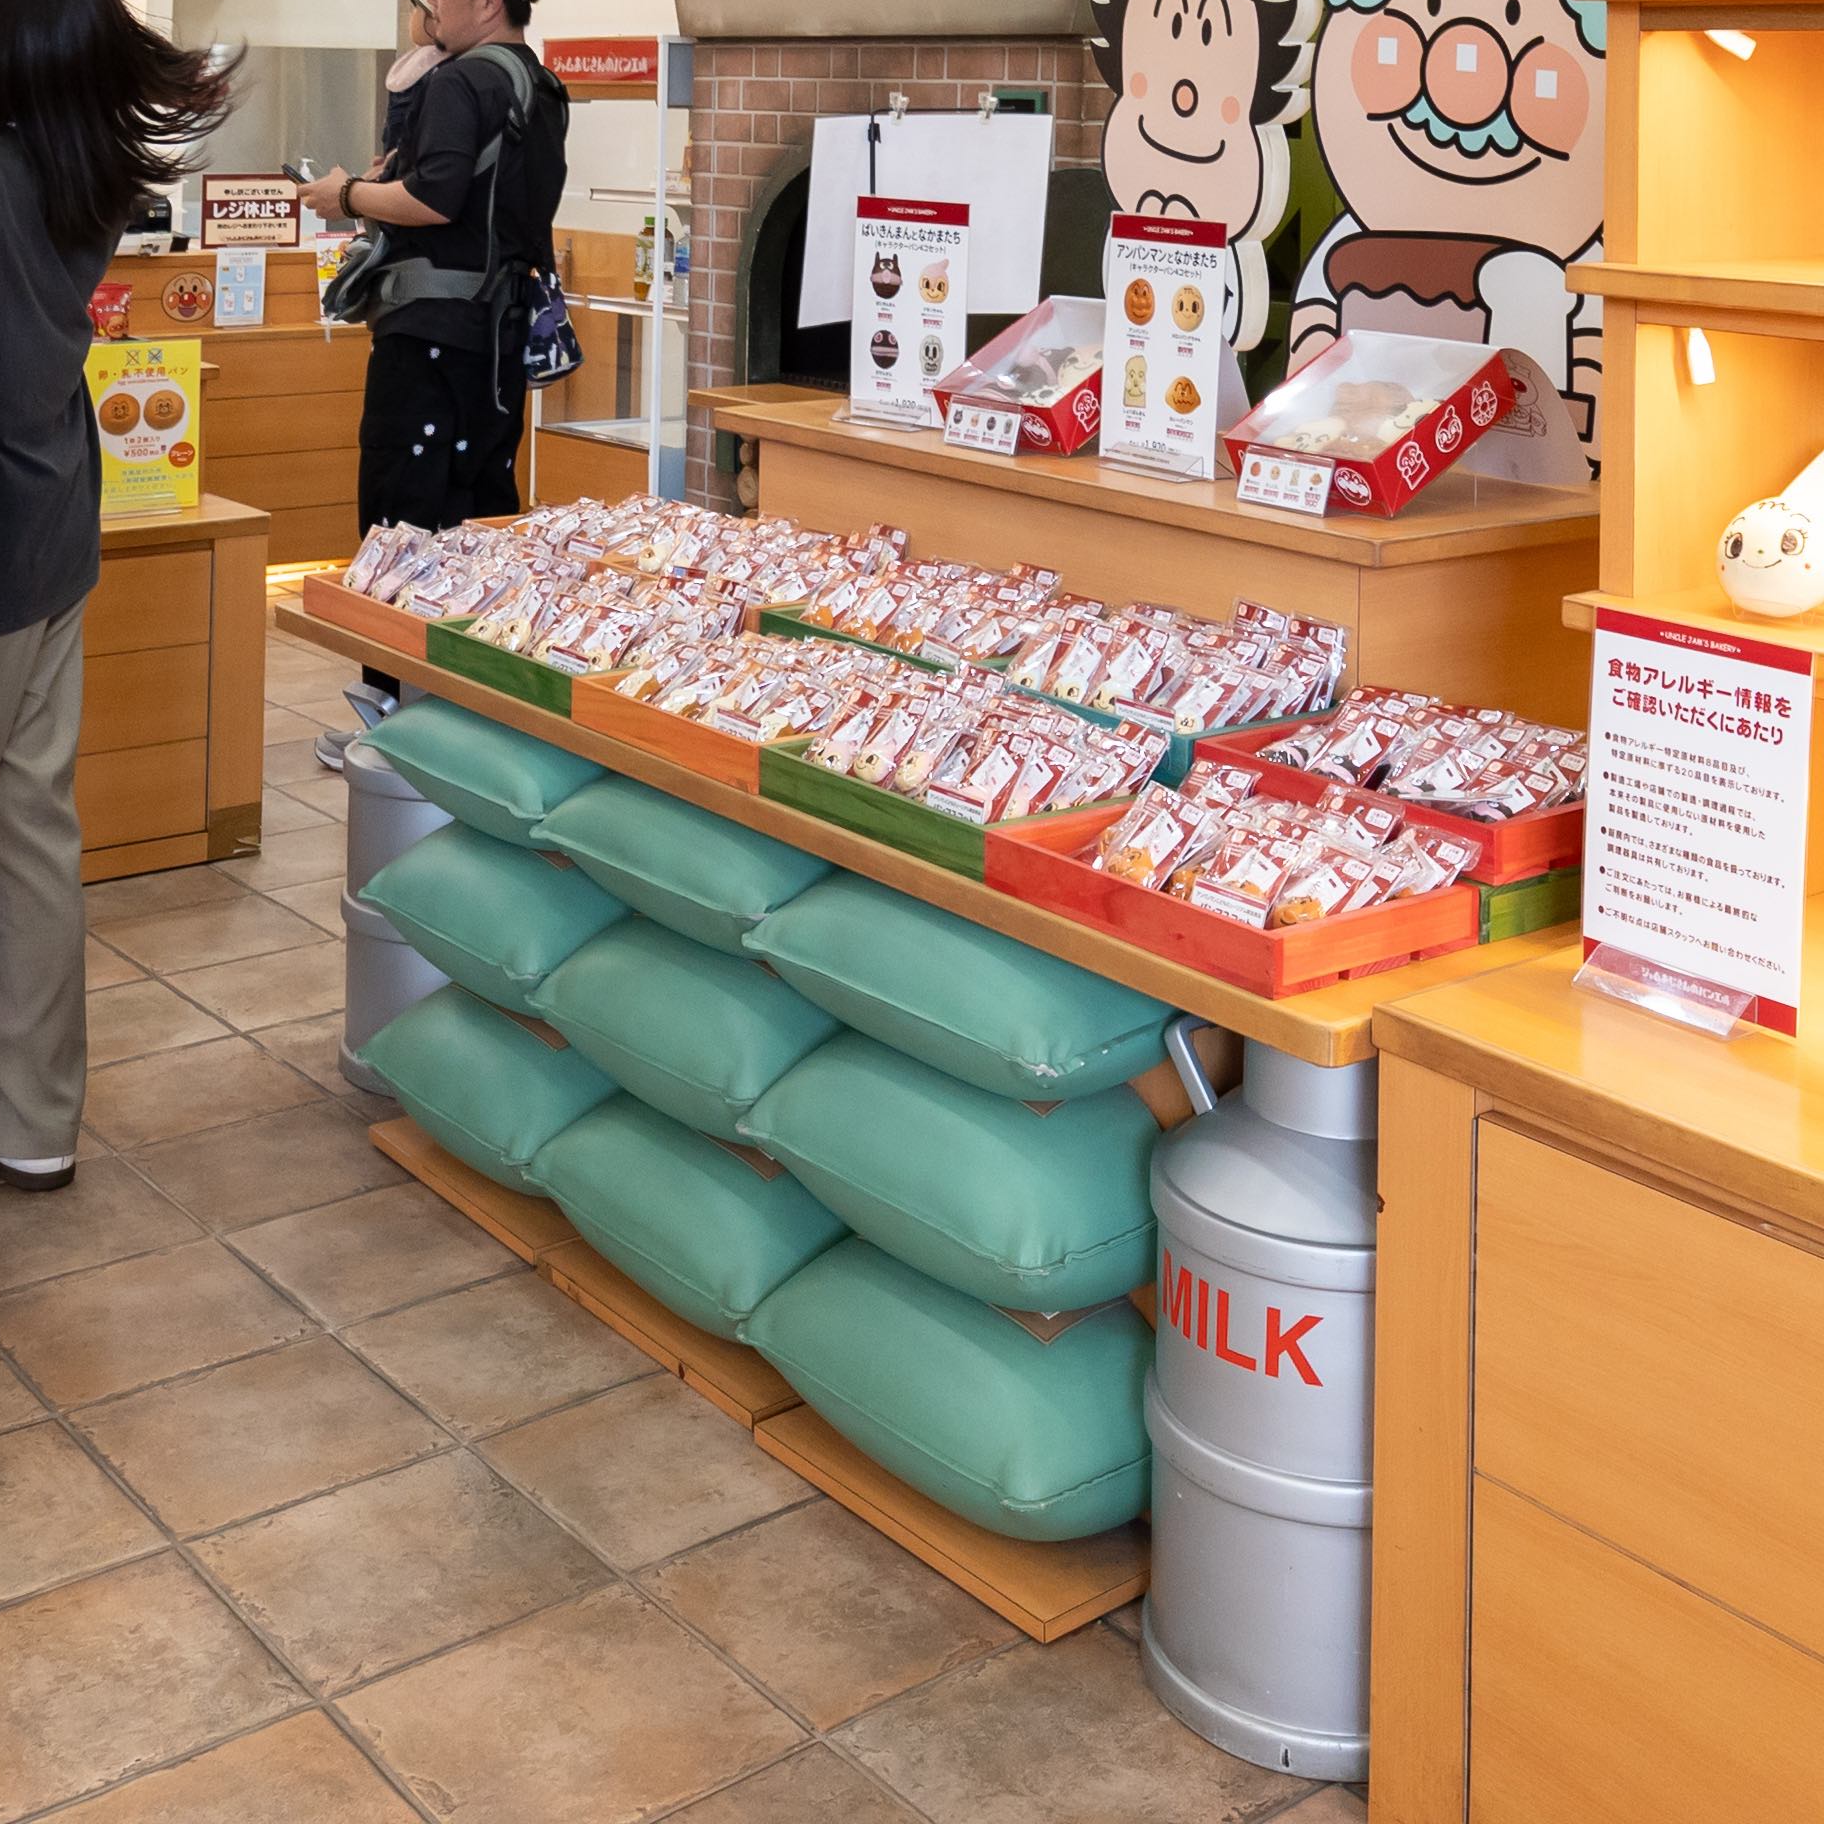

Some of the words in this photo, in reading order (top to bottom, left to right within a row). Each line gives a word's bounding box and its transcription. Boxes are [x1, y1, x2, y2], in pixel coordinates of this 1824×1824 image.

[212, 201, 291, 218] レジ休止中
[862, 224, 961, 245] ばいきんまんとなかまたち
[1117, 245, 1218, 269] アンパンマンとなかまたち
[98, 366, 188, 380] 卵・乳不使用パン
[1665, 632, 1686, 643] UNCLE
[1687, 637, 1709, 648] JAM'S
[1711, 641, 1737, 653] BAKERY
[1608, 658, 1792, 719] 食物アレルギー情報を
[1612, 688, 1784, 745] ご確認いただくにあたり
[1612, 733, 1750, 778] 食物アレルギー特定原材料8品目及び、
[1609, 803, 1693, 836] 製品を製造しております。
[1605, 907, 1785, 975] ご不明な点は店舗スタッフへお問い合わせください。
[1162, 1247, 1324, 1388] MILK
